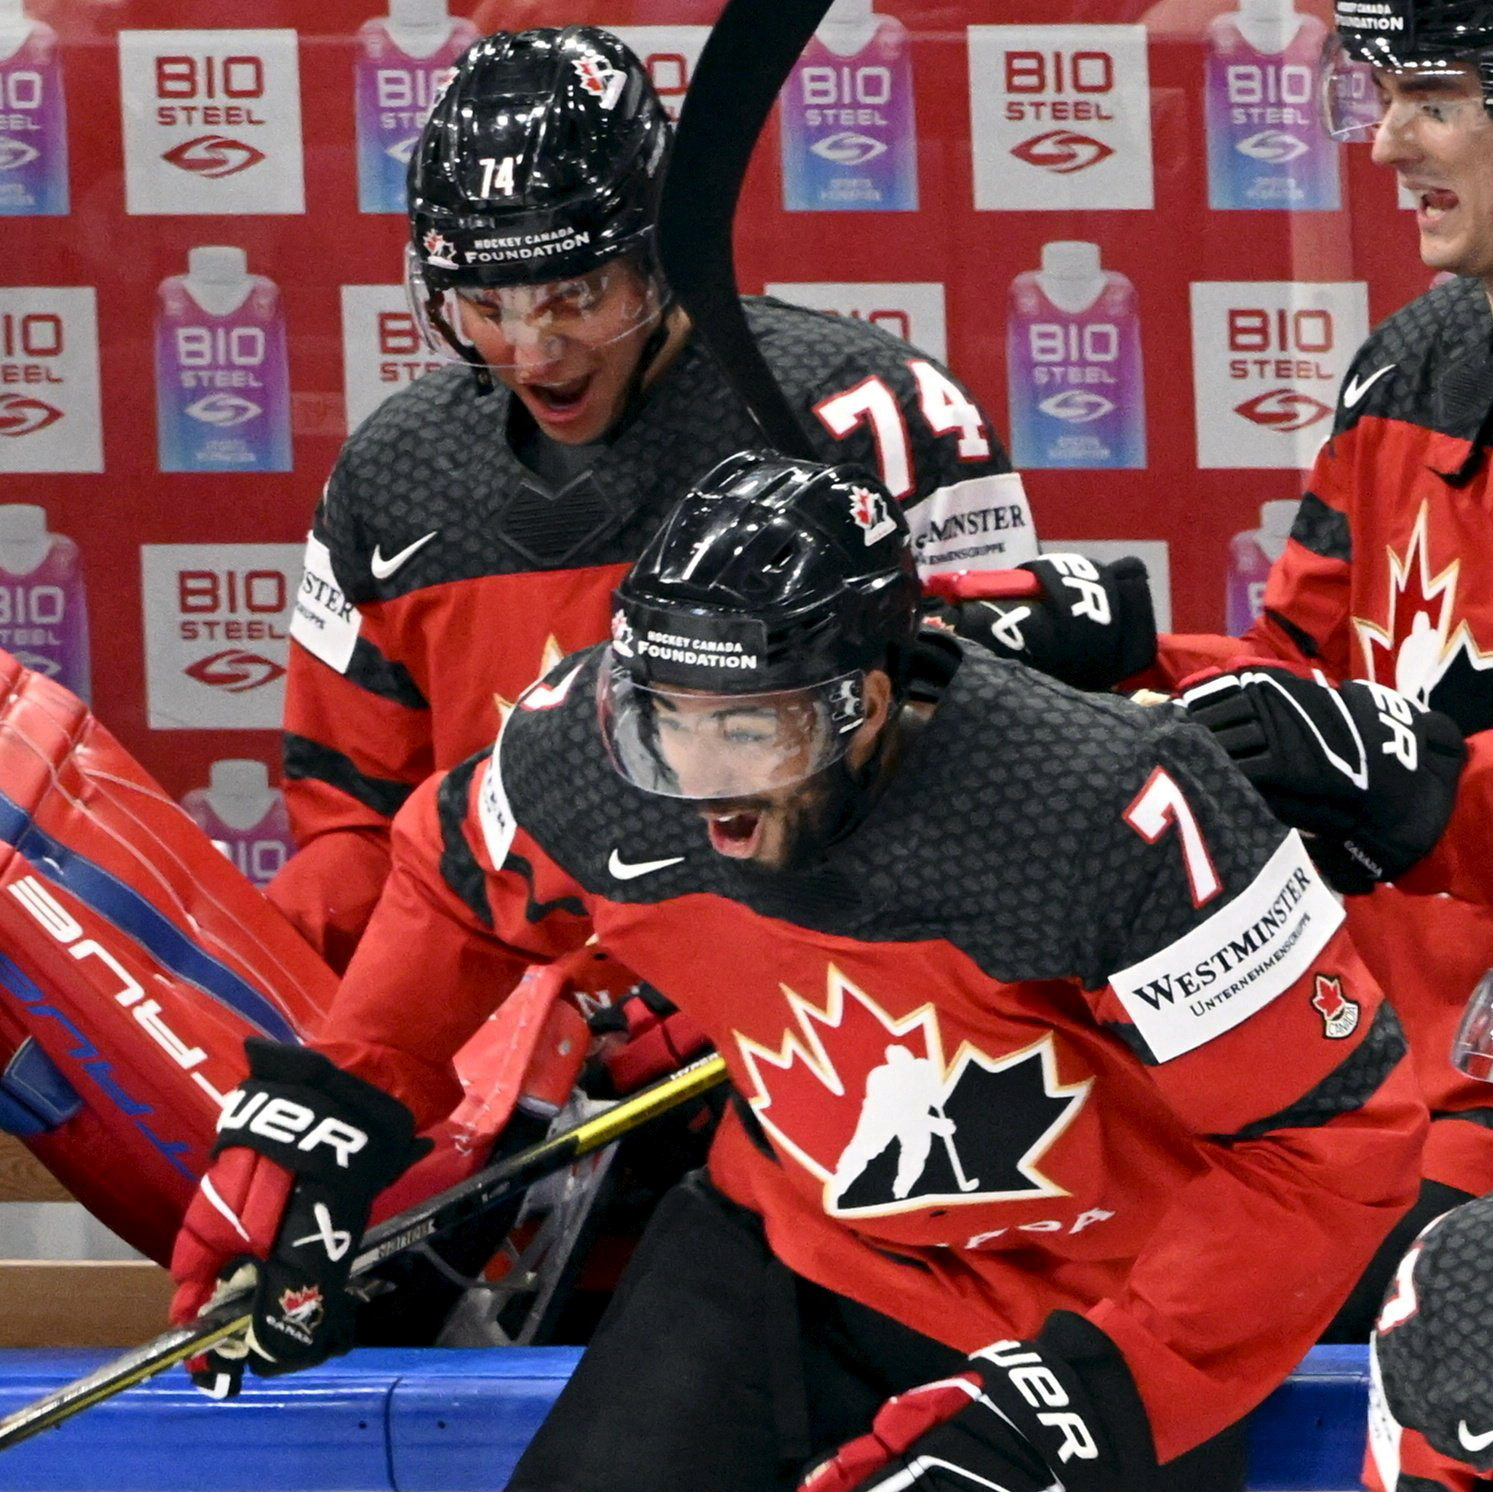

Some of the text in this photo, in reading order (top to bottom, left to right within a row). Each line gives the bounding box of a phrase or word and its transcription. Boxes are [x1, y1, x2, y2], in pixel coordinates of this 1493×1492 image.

[155, 56, 264, 99] BIO
[802, 66, 891, 105] BIO
[1004, 50, 1114, 94] BIO
[1226, 64, 1312, 104] BIO
[157, 105, 266, 126] STEEL
[805, 108, 889, 126] STEEL
[1005, 100, 1114, 121] STEEL
[1231, 107, 1310, 125] STEEL
[479, 157, 519, 199] 74
[464, 231, 591, 263] FOUNDATION
[474, 226, 576, 251] HOCKEY CANADA
[177, 326, 266, 366] BIO
[1029, 323, 1119, 363] BIO
[1228, 309, 1333, 353] BIO
[181, 370, 263, 388] STEEL
[1034, 366, 1117, 385] STEEL
[1230, 359, 1334, 379] STEEL
[814, 361, 990, 503] 74
[0, 585, 65, 625] IO
[178, 570, 287, 614] BIO
[180, 621, 288, 641] STEEL
[647, 630, 743, 654] HOCKEY CANADA
[637, 641, 758, 670] FOUNDATION
[1121, 765, 1223, 909] 7
[1131, 866, 1313, 1013] WESTMINSTER
